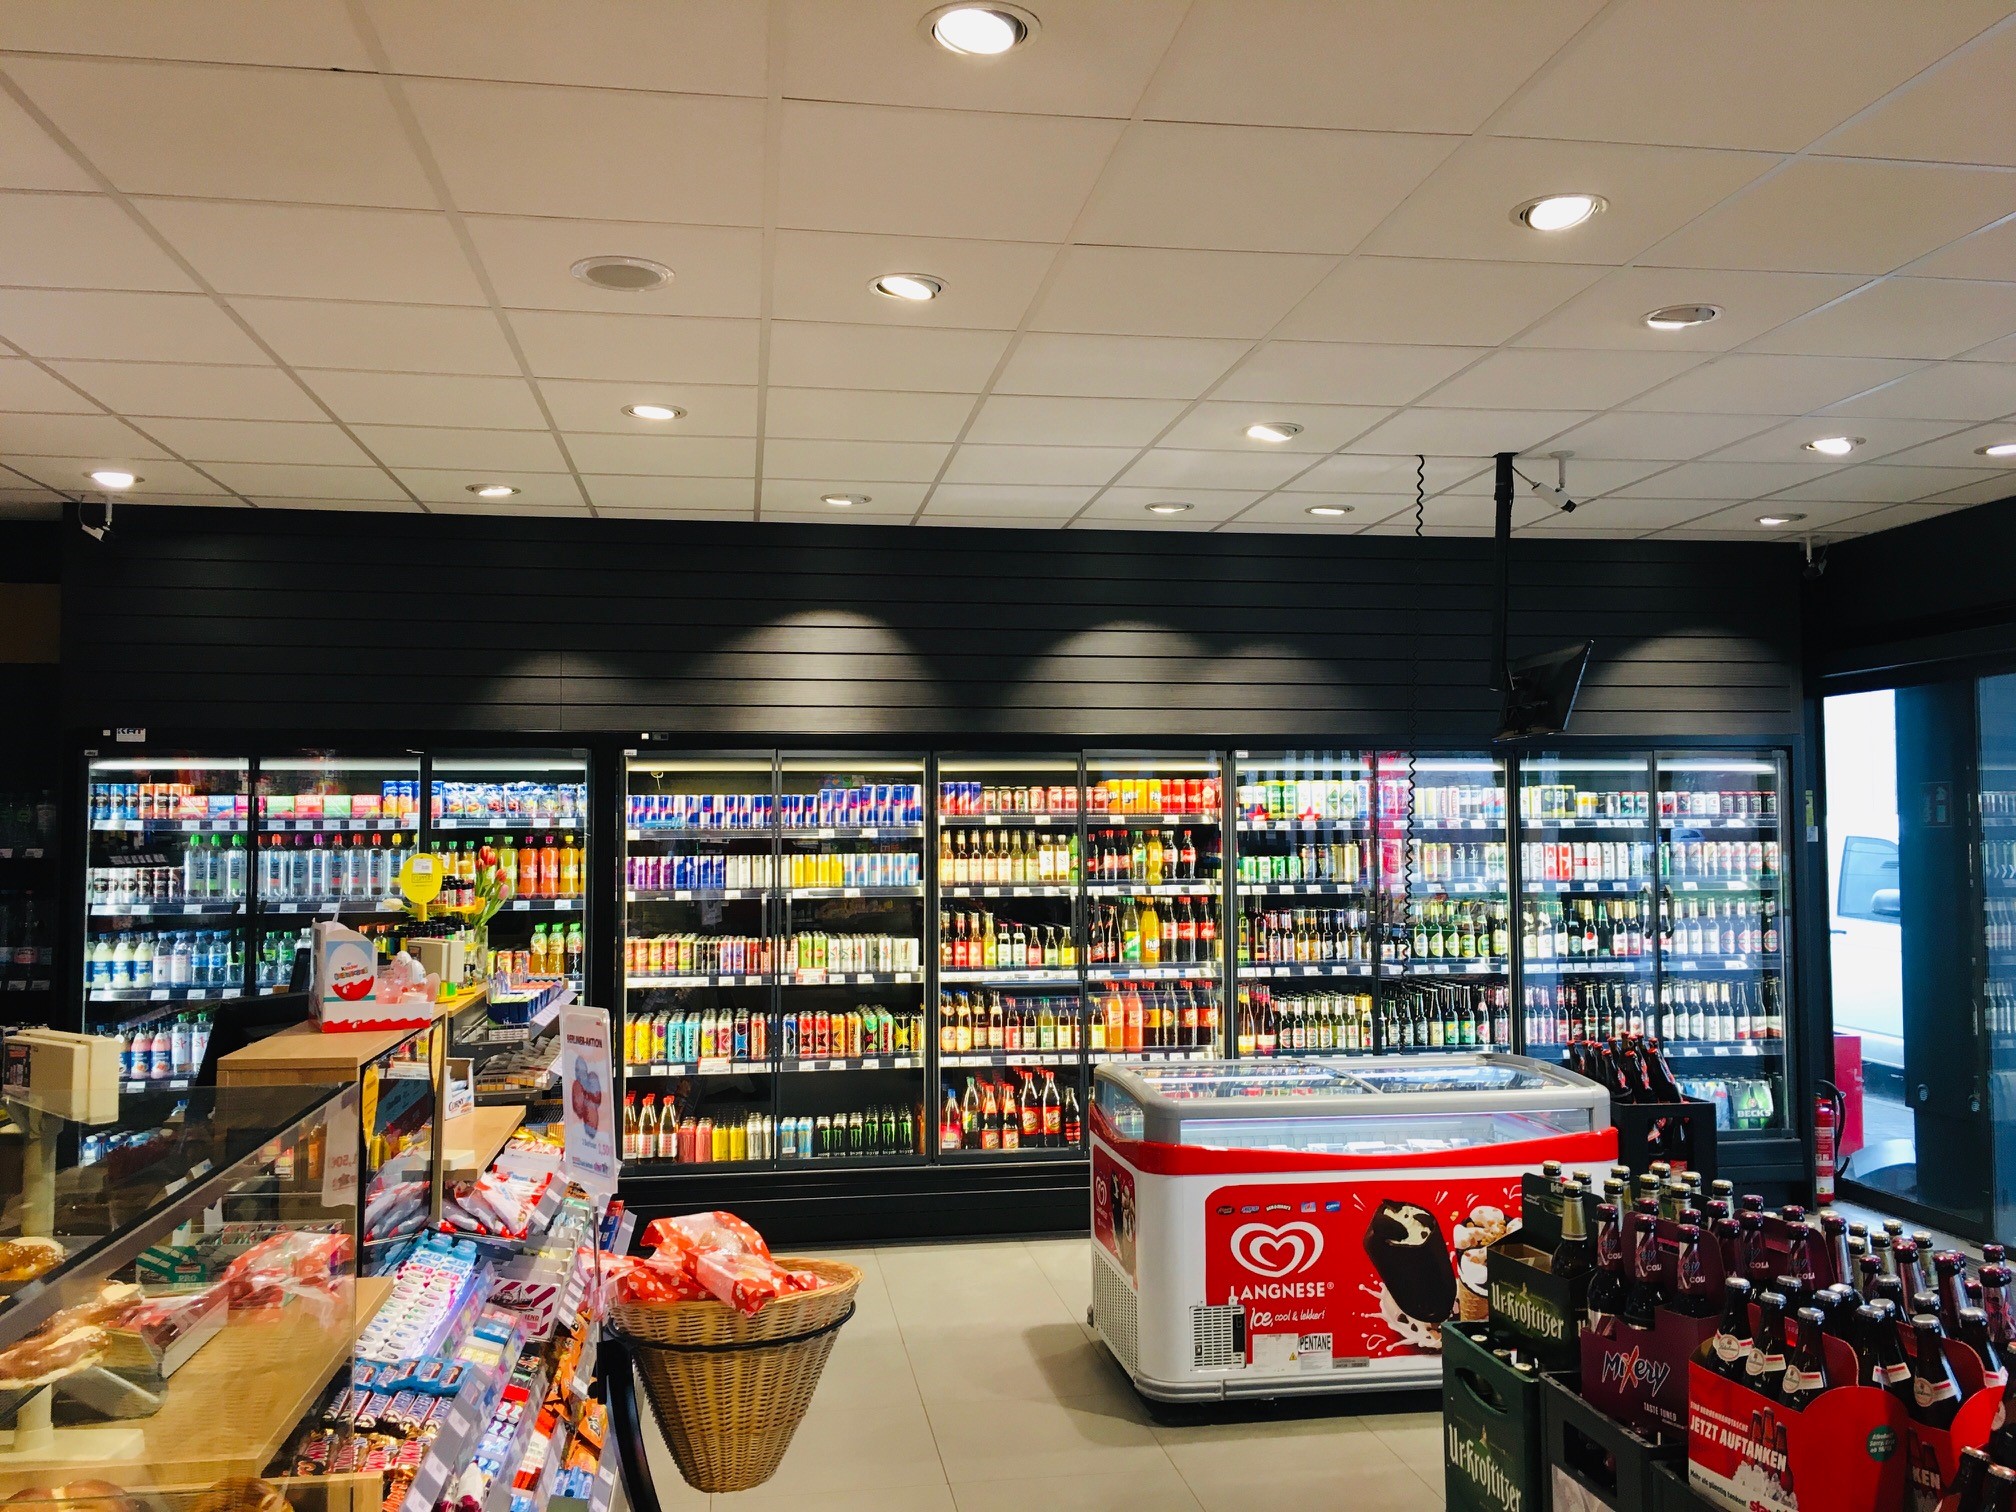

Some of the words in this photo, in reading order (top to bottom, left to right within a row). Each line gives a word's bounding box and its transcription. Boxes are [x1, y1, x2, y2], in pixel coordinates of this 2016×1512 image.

[1230, 1282, 1325, 1301] LANGNESE
[1275, 1310, 1290, 1321] cool
[1292, 1311, 1298, 1321] &
[1300, 1335, 1331, 1351] PENTANE
[1690, 1414, 1719, 1441] JETZT
[1719, 1428, 1787, 1472] AUFTANKEN
